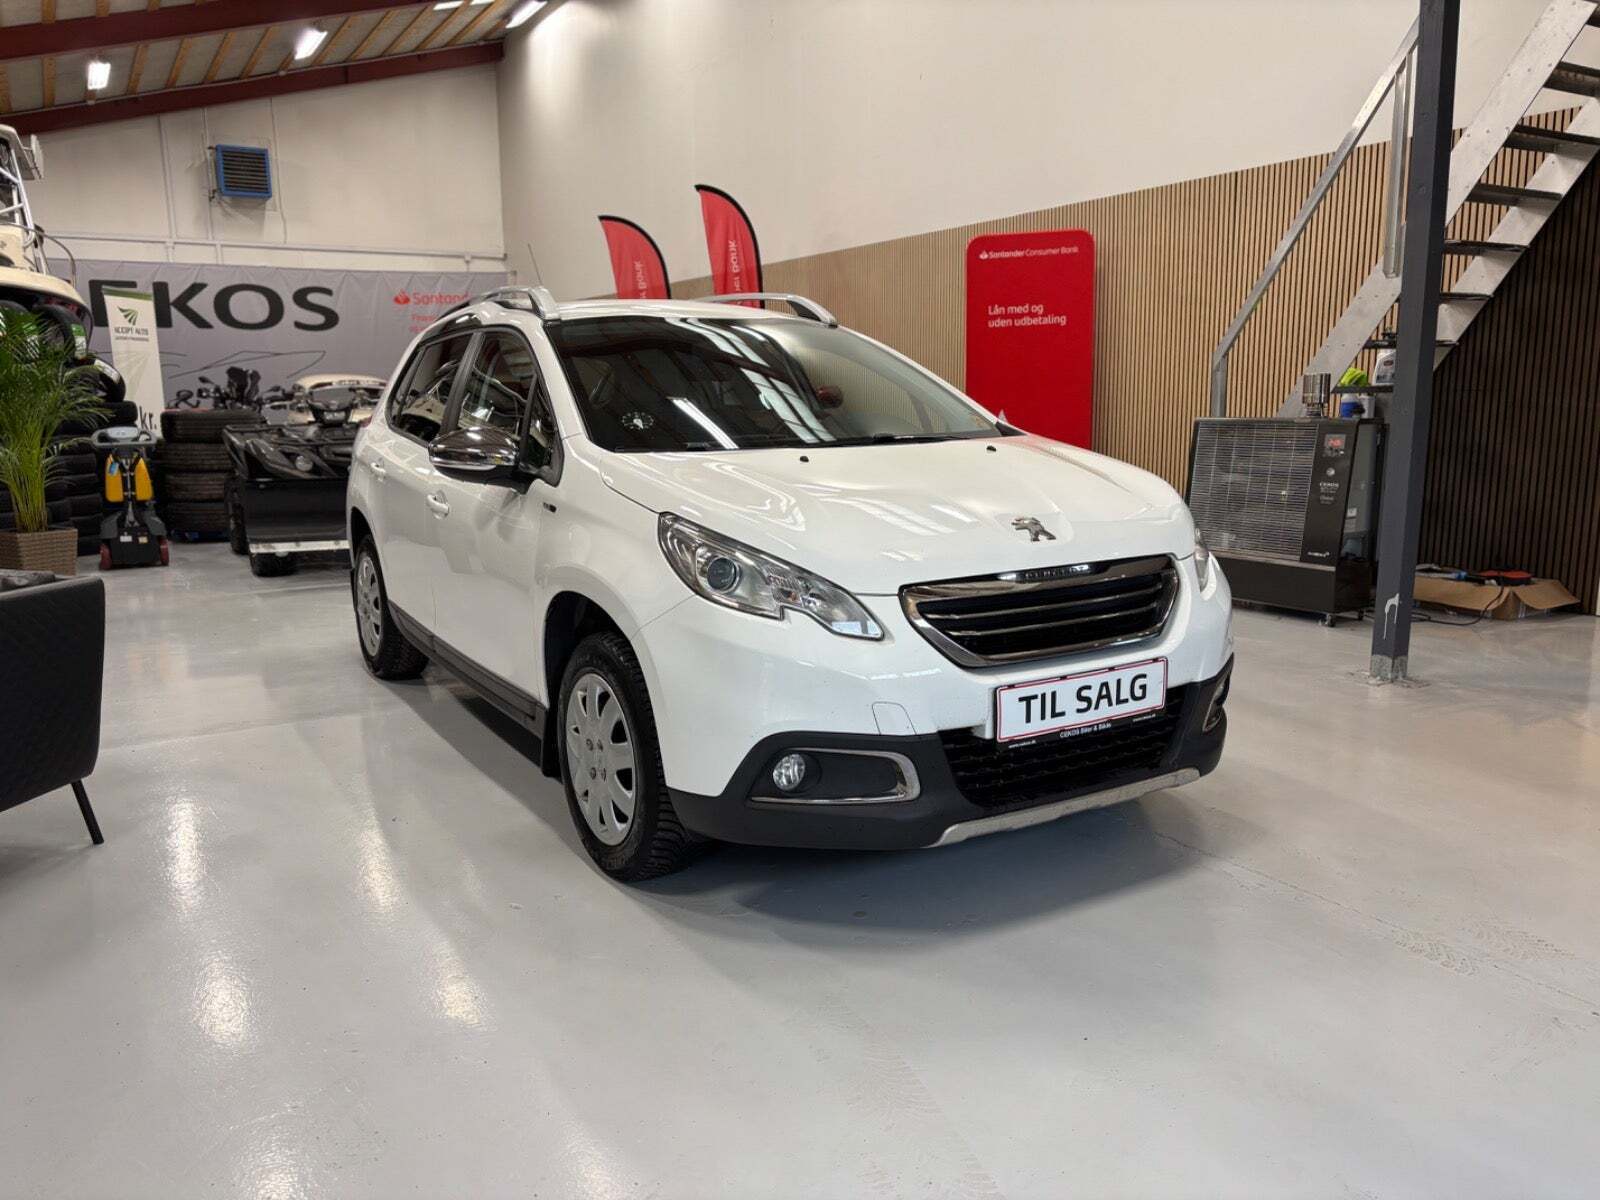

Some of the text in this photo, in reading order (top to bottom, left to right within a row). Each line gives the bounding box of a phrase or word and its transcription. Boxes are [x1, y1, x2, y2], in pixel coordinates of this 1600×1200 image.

[988, 245, 1079, 259] Santander Consumer Bank
[988, 303, 1044, 316] Lån med og
[988, 313, 1067, 328] uden udbetaling
[138, 405, 158, 431] kr.
[1018, 673, 1148, 724] TIL SALG
